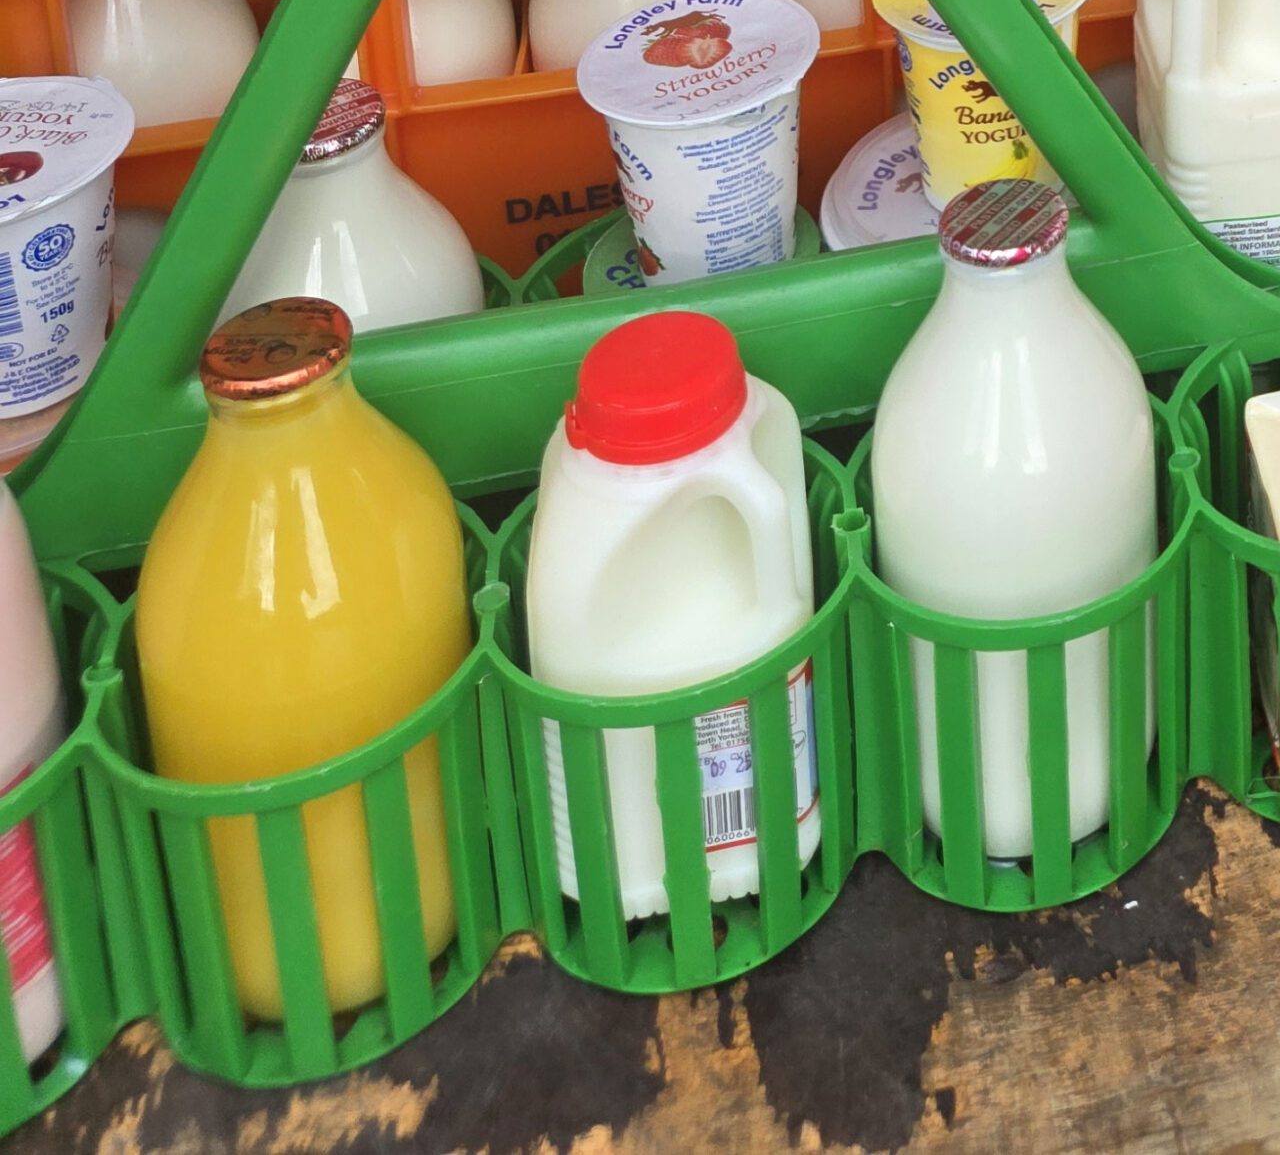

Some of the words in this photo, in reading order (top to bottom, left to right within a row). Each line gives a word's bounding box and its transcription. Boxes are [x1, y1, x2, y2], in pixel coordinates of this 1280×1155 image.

[605, 0, 677, 50] Longley
[653, 43, 778, 99] Strawberry
[678, 60, 770, 102] YOGURT
[857, 144, 921, 212] Longley
[40, 299, 75, 323] 150g
[9, 359, 27, 368] NOT
[28, 352, 47, 363] FOR
[701, 714, 722, 724] Fresh
[723, 710, 742, 721] from
